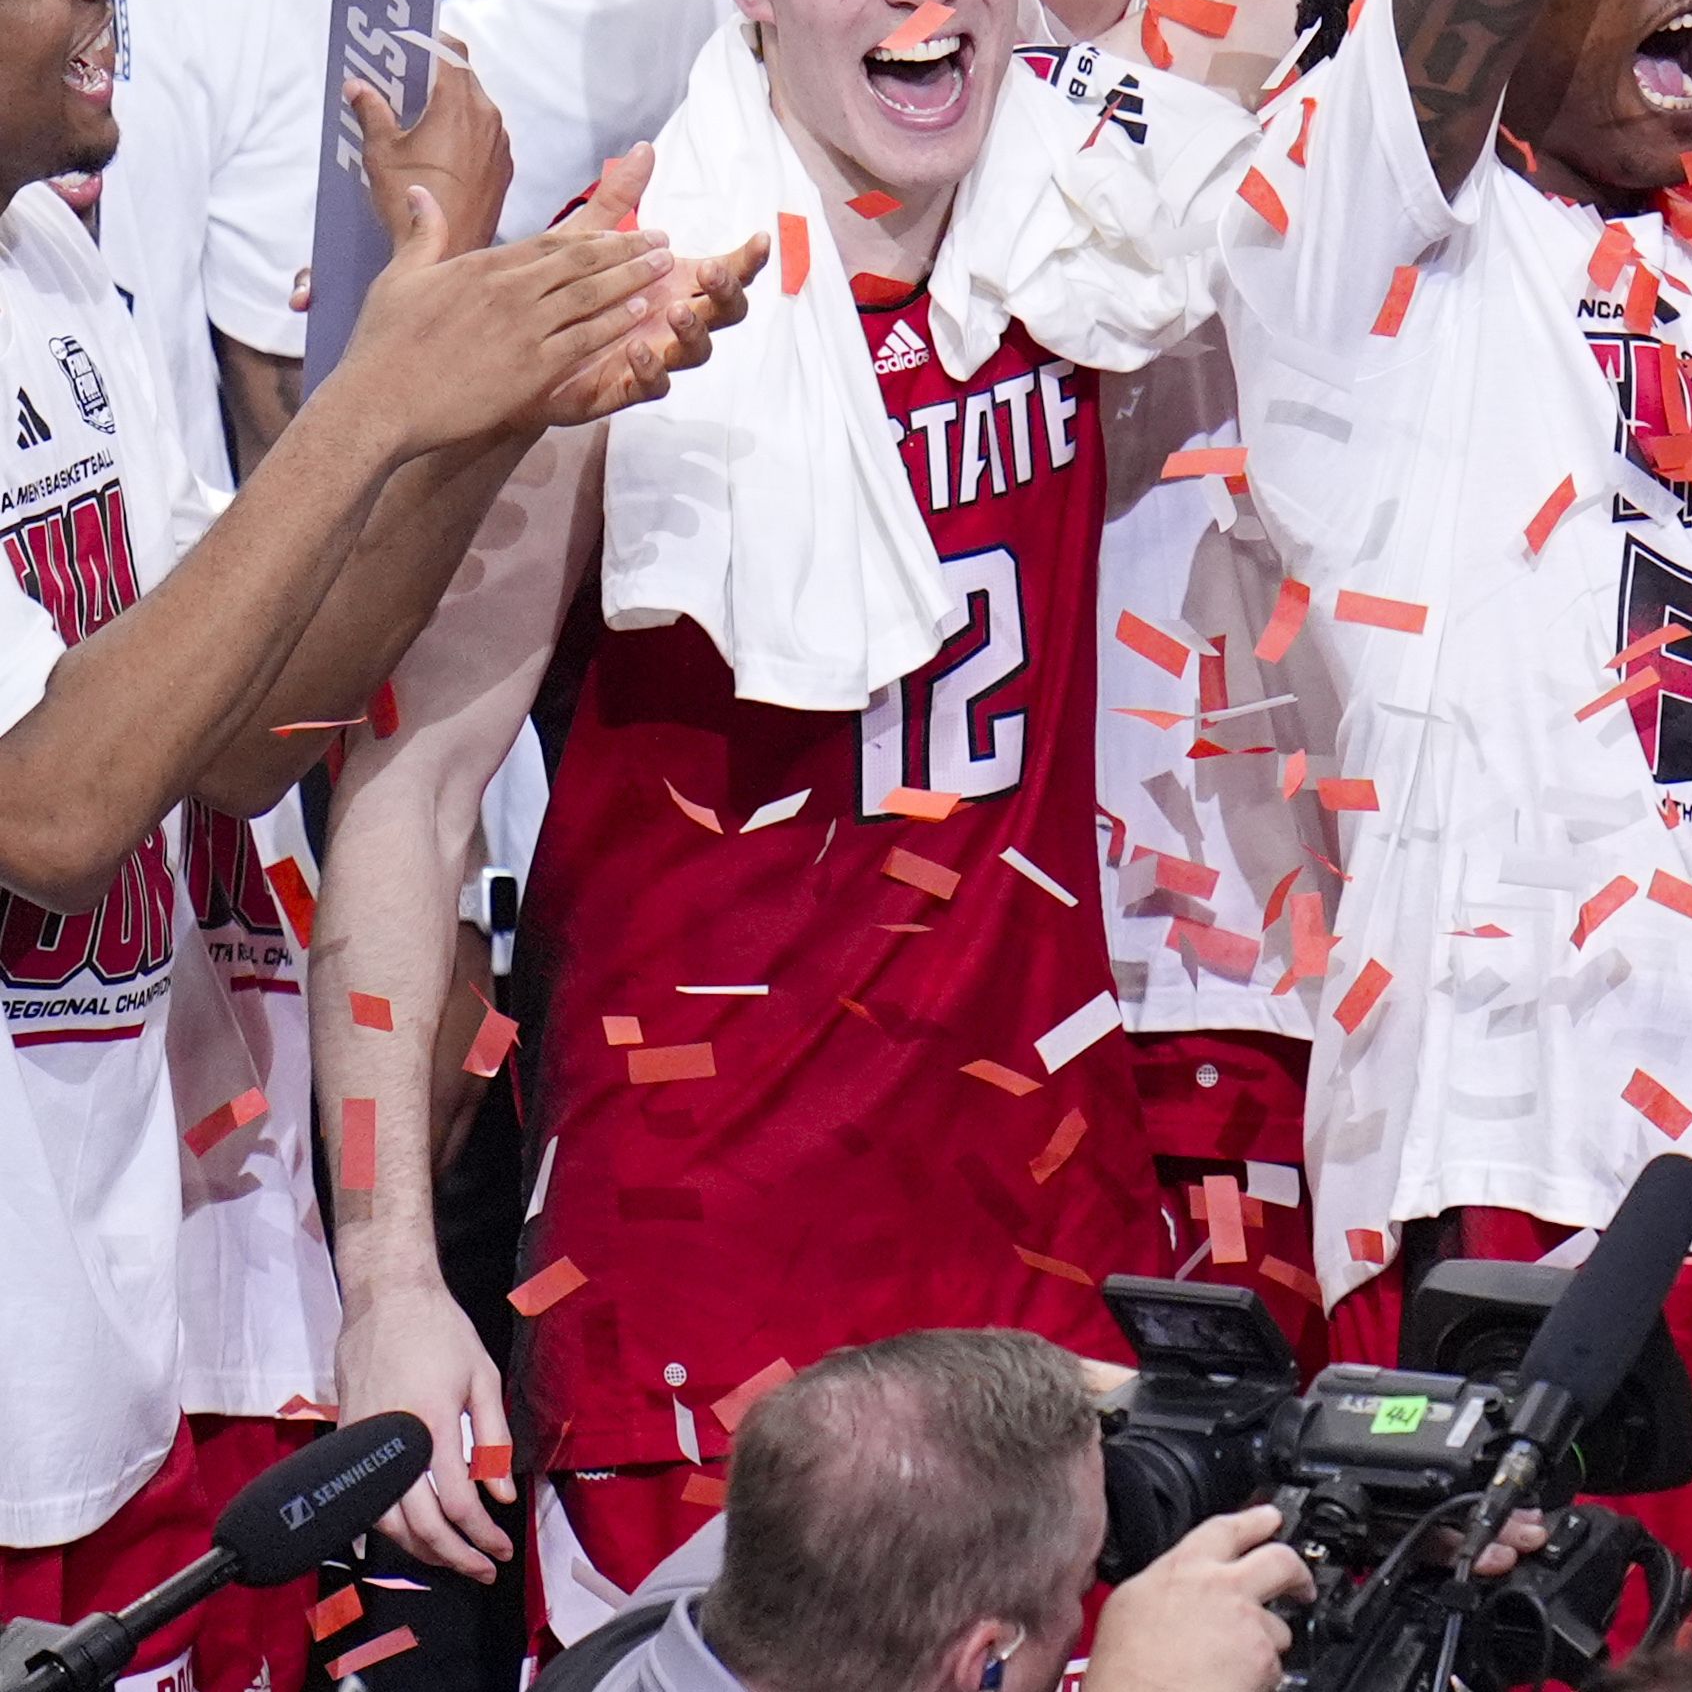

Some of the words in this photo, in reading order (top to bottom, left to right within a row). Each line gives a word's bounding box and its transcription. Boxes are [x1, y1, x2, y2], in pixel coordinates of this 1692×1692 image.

[875, 349, 930, 374] adidas
[46, 447, 115, 495] BASKETBALL
[312, 1436, 408, 1508] SENNHEISER
